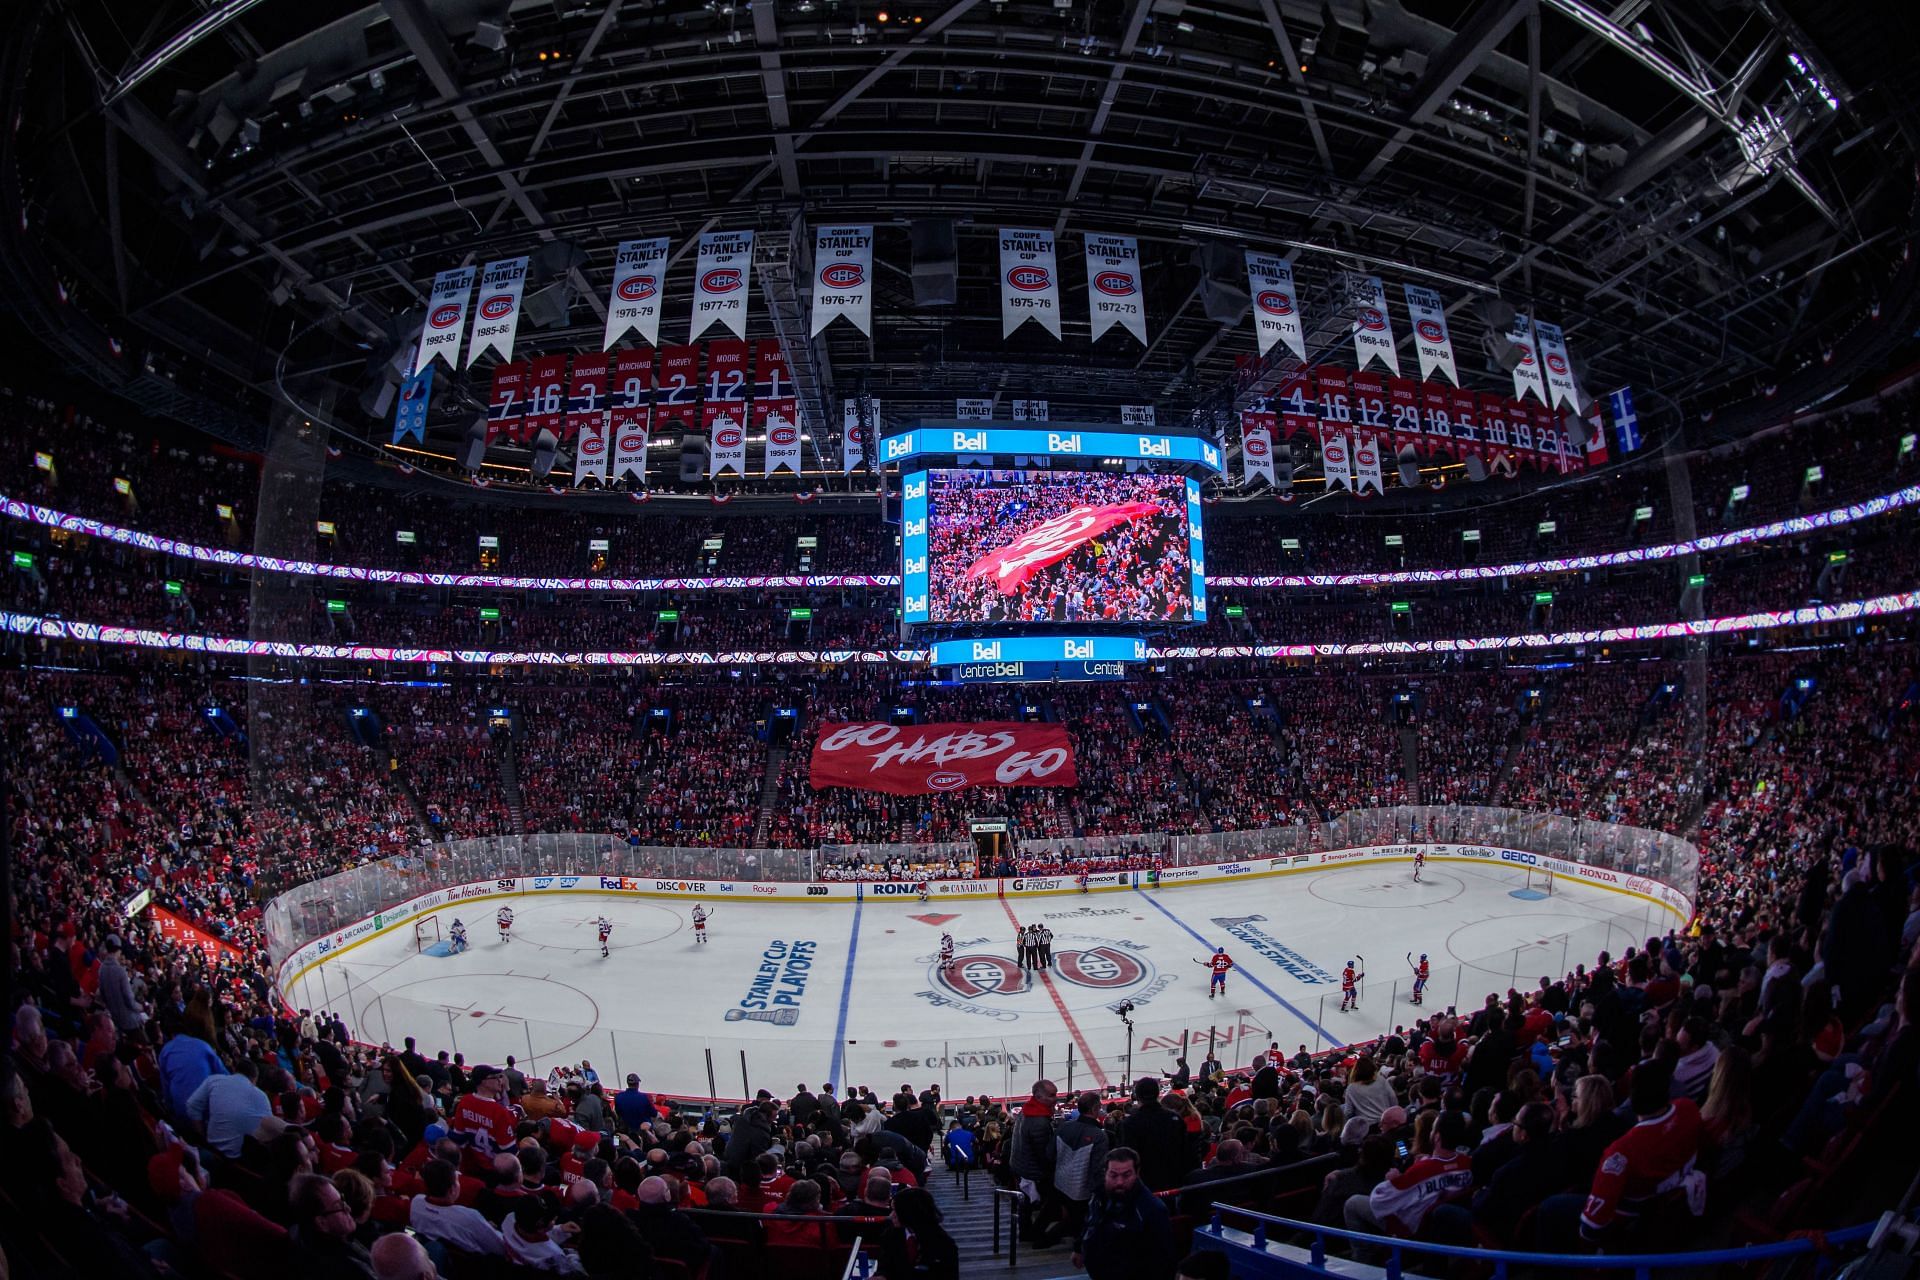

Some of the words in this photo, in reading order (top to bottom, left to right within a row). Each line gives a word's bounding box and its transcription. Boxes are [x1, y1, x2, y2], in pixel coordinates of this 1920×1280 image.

[713, 234, 740, 243] COUPE
[831, 228, 860, 236] COUPE
[1013, 232, 1041, 240] COUPE
[631, 241, 657, 250] COUPE
[700, 241, 751, 256] STANLEY
[819, 236, 871, 249] STANLEY
[1002, 239, 1053, 253] STANLEY
[1098, 237, 1125, 246] COUPE
[618, 248, 666, 264] STANLEY
[716, 255, 733, 263] CUP
[835, 249, 853, 257] CUP
[1019, 252, 1037, 260] CUP
[1087, 244, 1137, 259] STANLEY
[495, 261, 518, 270] COUPE
[632, 262, 648, 270] CUP
[1105, 258, 1122, 266] CUP
[1257, 256, 1281, 267] COUPE
[484, 266, 526, 284] STANLEY
[1249, 263, 1291, 281] STANLEY
[434, 276, 473, 294] STANLEY
[495, 282, 509, 290] CUP
[1264, 278, 1279, 286] CUP
[444, 291, 458, 299] CUP
[820, 295, 862, 305] 1976-77
[1009, 297, 1052, 309] 1975-76
[1407, 294, 1440, 310] STANLEY
[615, 306, 654, 319] 1978-79
[1096, 302, 1137, 314] 1972-73
[1260, 319, 1296, 333] 1970-71
[426, 333, 456, 346] 1992-93
[667, 357, 692, 367] HARVEY
[716, 353, 741, 363] MOORE
[668, 373, 687, 406] 2
[708, 369, 744, 402] 12
[768, 368, 782, 400] 1
[531, 383, 561, 416] 16
[578, 383, 597, 414] 3
[623, 377, 641, 409] 9
[499, 389, 516, 421] 7
[1290, 386, 1308, 417] 4
[1321, 392, 1350, 423] 16
[958, 406, 991, 416] STANLEY
[1123, 413, 1153, 422] STANLEY
[1357, 396, 1389, 427] 12
[1393, 403, 1421, 433] 29
[1426, 407, 1450, 437] 18
[1461, 413, 1475, 441] 5
[1485, 417, 1509, 446] 10
[1511, 422, 1533, 450] 19
[888, 434, 912, 458] Bell
[953, 431, 987, 452] Bell
[1048, 433, 1081, 453] Bell
[1139, 437, 1171, 457] Bell
[1203, 442, 1217, 466] Bell
[905, 480, 925, 500] Bell
[1187, 486, 1200, 504] Bell
[905, 517, 925, 537] Bell
[1190, 523, 1202, 541] Bell
[905, 555, 925, 574] Bell
[1192, 558, 1204, 577] Bell
[905, 593, 926, 613] Bell
[1194, 595, 1206, 613] Bell
[973, 642, 1001, 660] Bell
[1064, 640, 1094, 659] Bell
[820, 723, 899, 751] GO
[866, 729, 1016, 773] HABS
[995, 747, 1067, 783] GO
[1501, 850, 1537, 865] GEICO
[1217, 863, 1240, 873] sports
[1225, 866, 1251, 875] experts
[1579, 867, 1618, 883] HONDA
[535, 878, 551, 888] SAP
[560, 877, 576, 887] SAP
[600, 876, 638, 891] FedEx
[656, 881, 706, 893] DISCOVER
[720, 883, 734, 893] Bell
[752, 884, 777, 895] Rouge
[873, 884, 918, 895] RONA
[951, 882, 988, 893] CANADIAN
[1026, 879, 1063, 891] FROST
[446, 889, 460, 901] Tim
[344, 930, 353, 940] AIR
[352, 921, 374, 936] CANADA
[318, 938, 331, 954] Bell
[1226, 927, 1269, 951] COUPE
[1260, 950, 1324, 985] STANLEY
[740, 959, 781, 1010] STANLEY
[763, 939, 789, 960] CUP
[773, 940, 818, 1006] PLAYOFFS
[925, 1051, 1034, 1069] CANADIAN
[474, 1127, 496, 1159] 4
